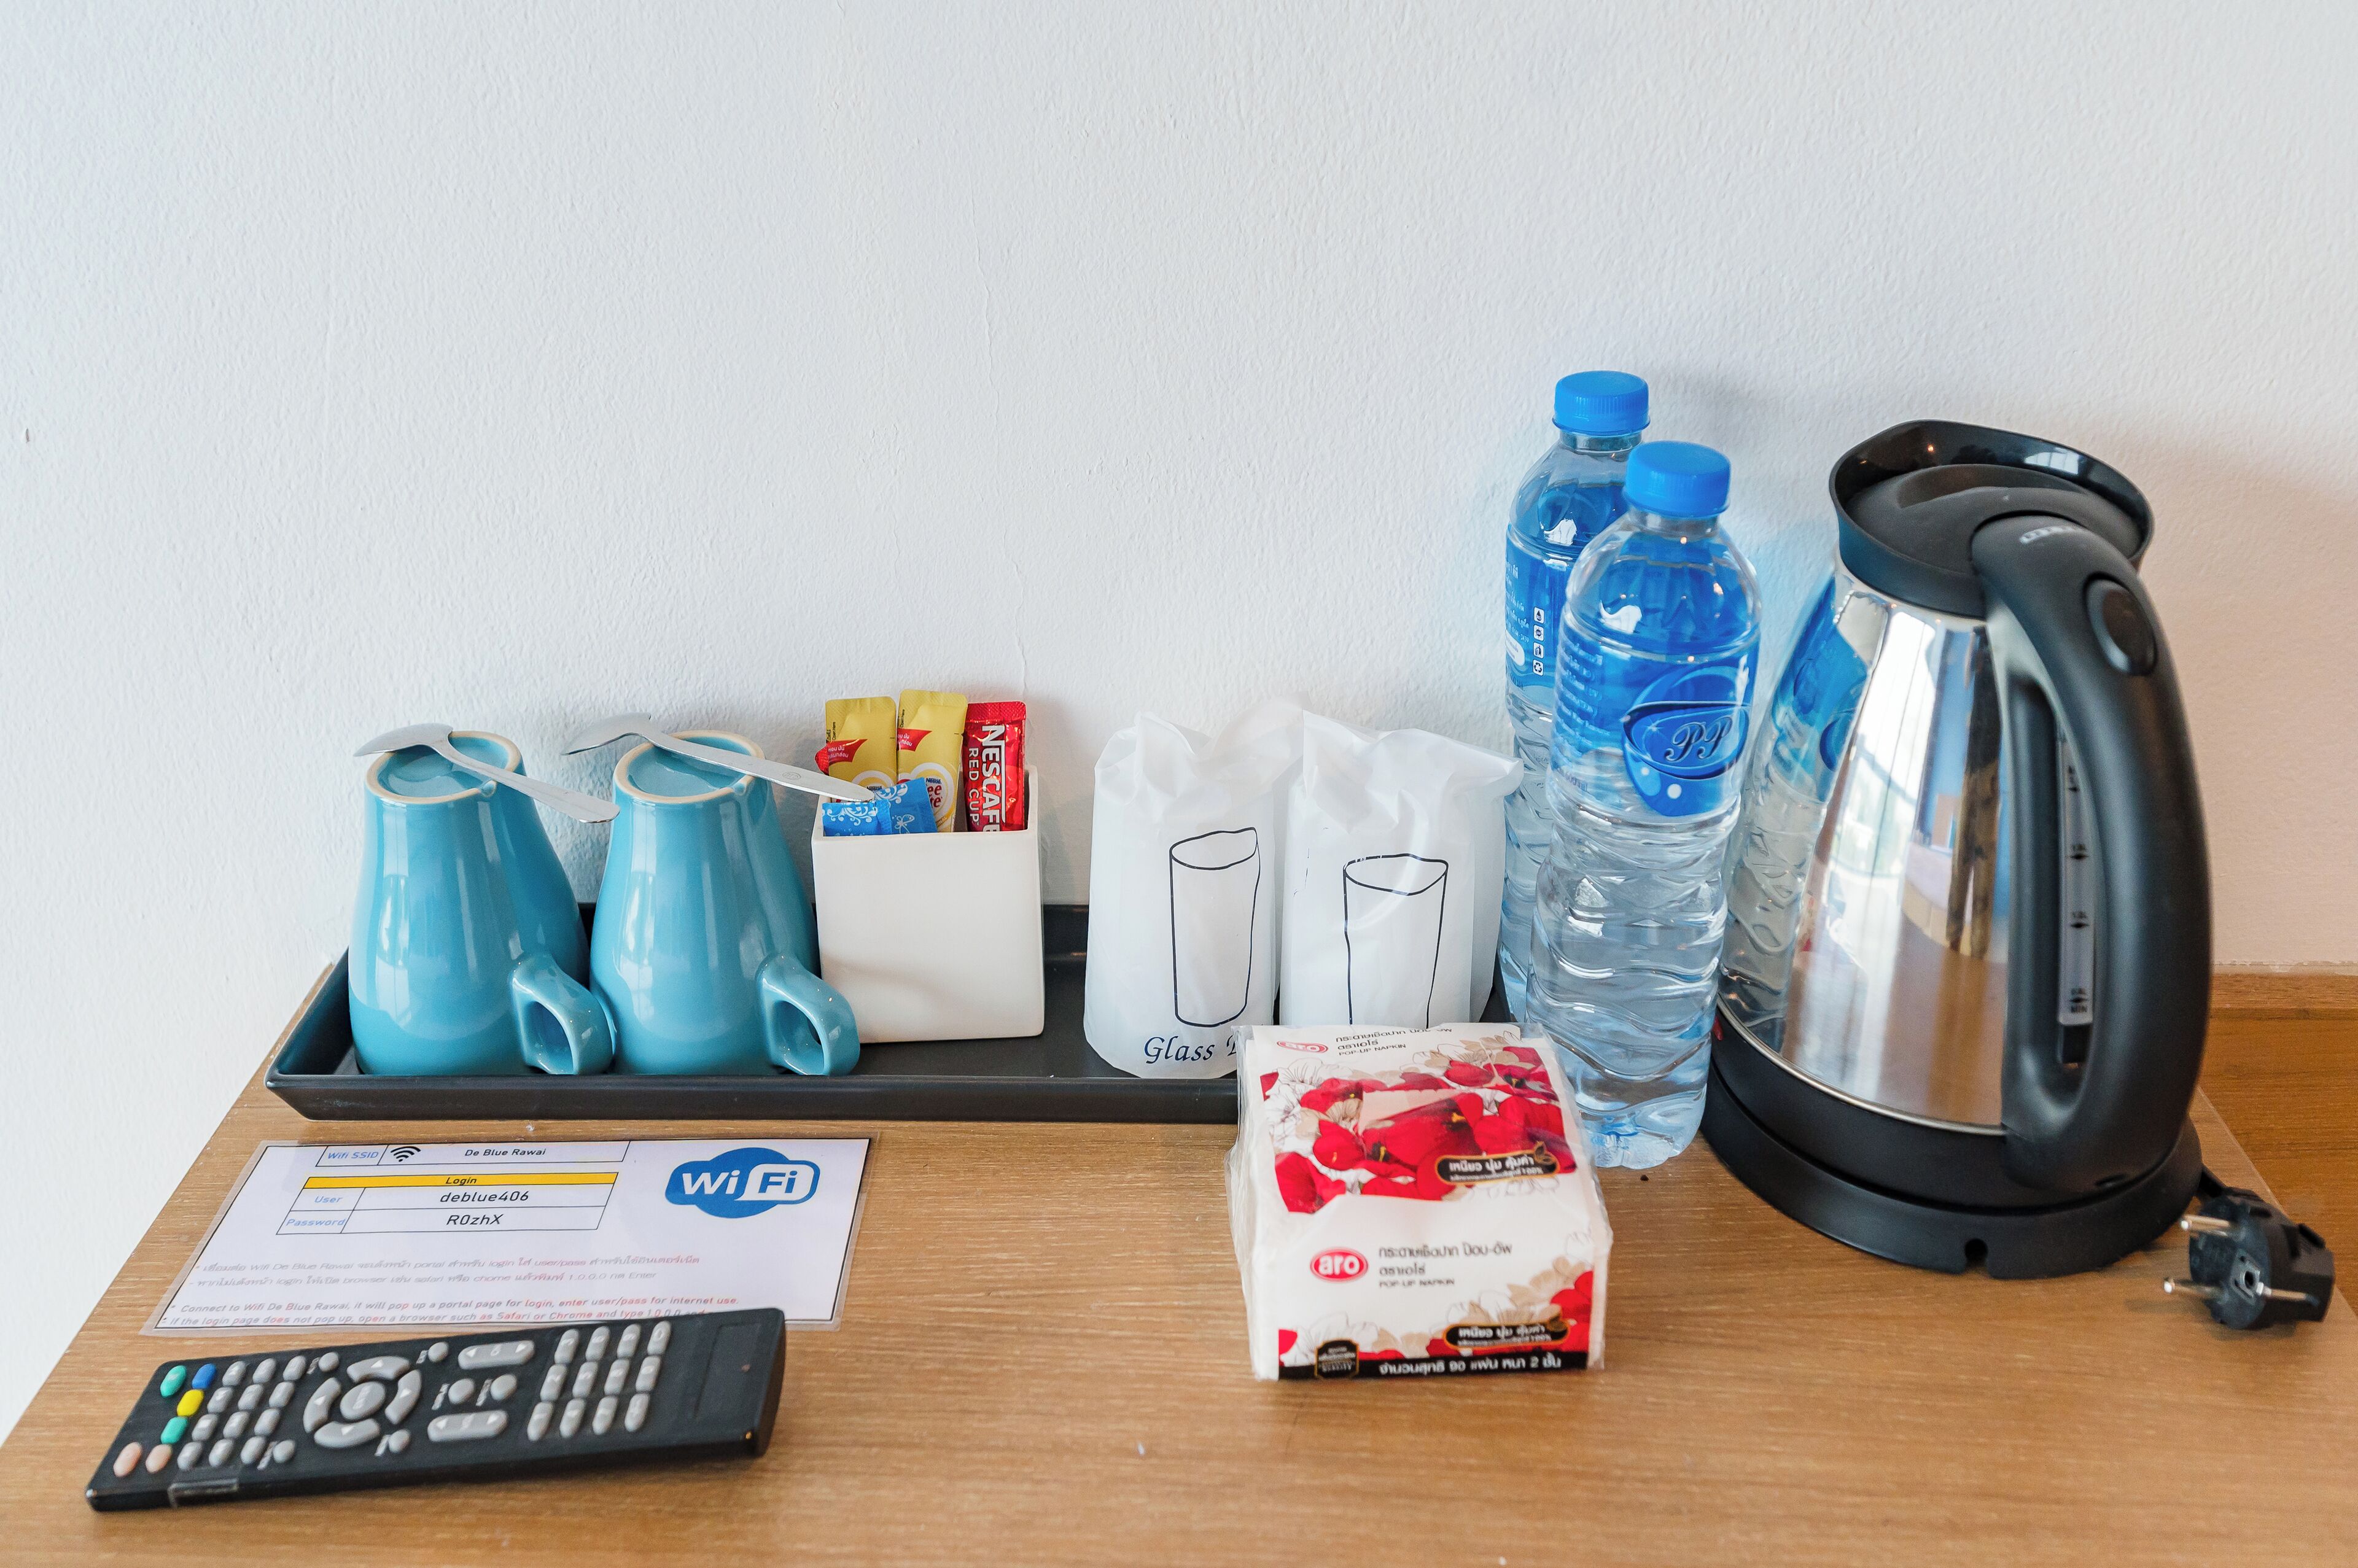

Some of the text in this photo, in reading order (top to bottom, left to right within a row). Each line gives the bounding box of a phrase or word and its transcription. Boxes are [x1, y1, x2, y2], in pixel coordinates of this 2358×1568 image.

[968, 748, 979, 822] RED CUP
[1144, 1036, 1215, 1064] Glass
[445, 1177, 477, 1186] Login
[440, 1190, 529, 1203] deblue406
[534, 1259, 586, 1267] user/pass
[1318, 1255, 1360, 1276] aro
[276, 1277, 302, 1286] login
[181, 1304, 230, 1313] Connect
[286, 1302, 311, 1311] Blue
[387, 1302, 410, 1311] pop
[438, 1300, 472, 1310] portal
[475, 1300, 502, 1309] page
[524, 1298, 554, 1309] login,
[559, 1298, 588, 1307] enter
[591, 1296, 647, 1309] user/pass
[669, 1296, 714, 1305] internet
[169, 1316, 180, 1325] If
[202, 1316, 229, 1326] login
[231, 1316, 259, 1326] page
[313, 1316, 335, 1325] pop
[359, 1315, 386, 1324] open
[550, 1310, 593, 1320] Chrome
[620, 1310, 644, 1320] type
[1530, 1356, 1539, 1368] 2
